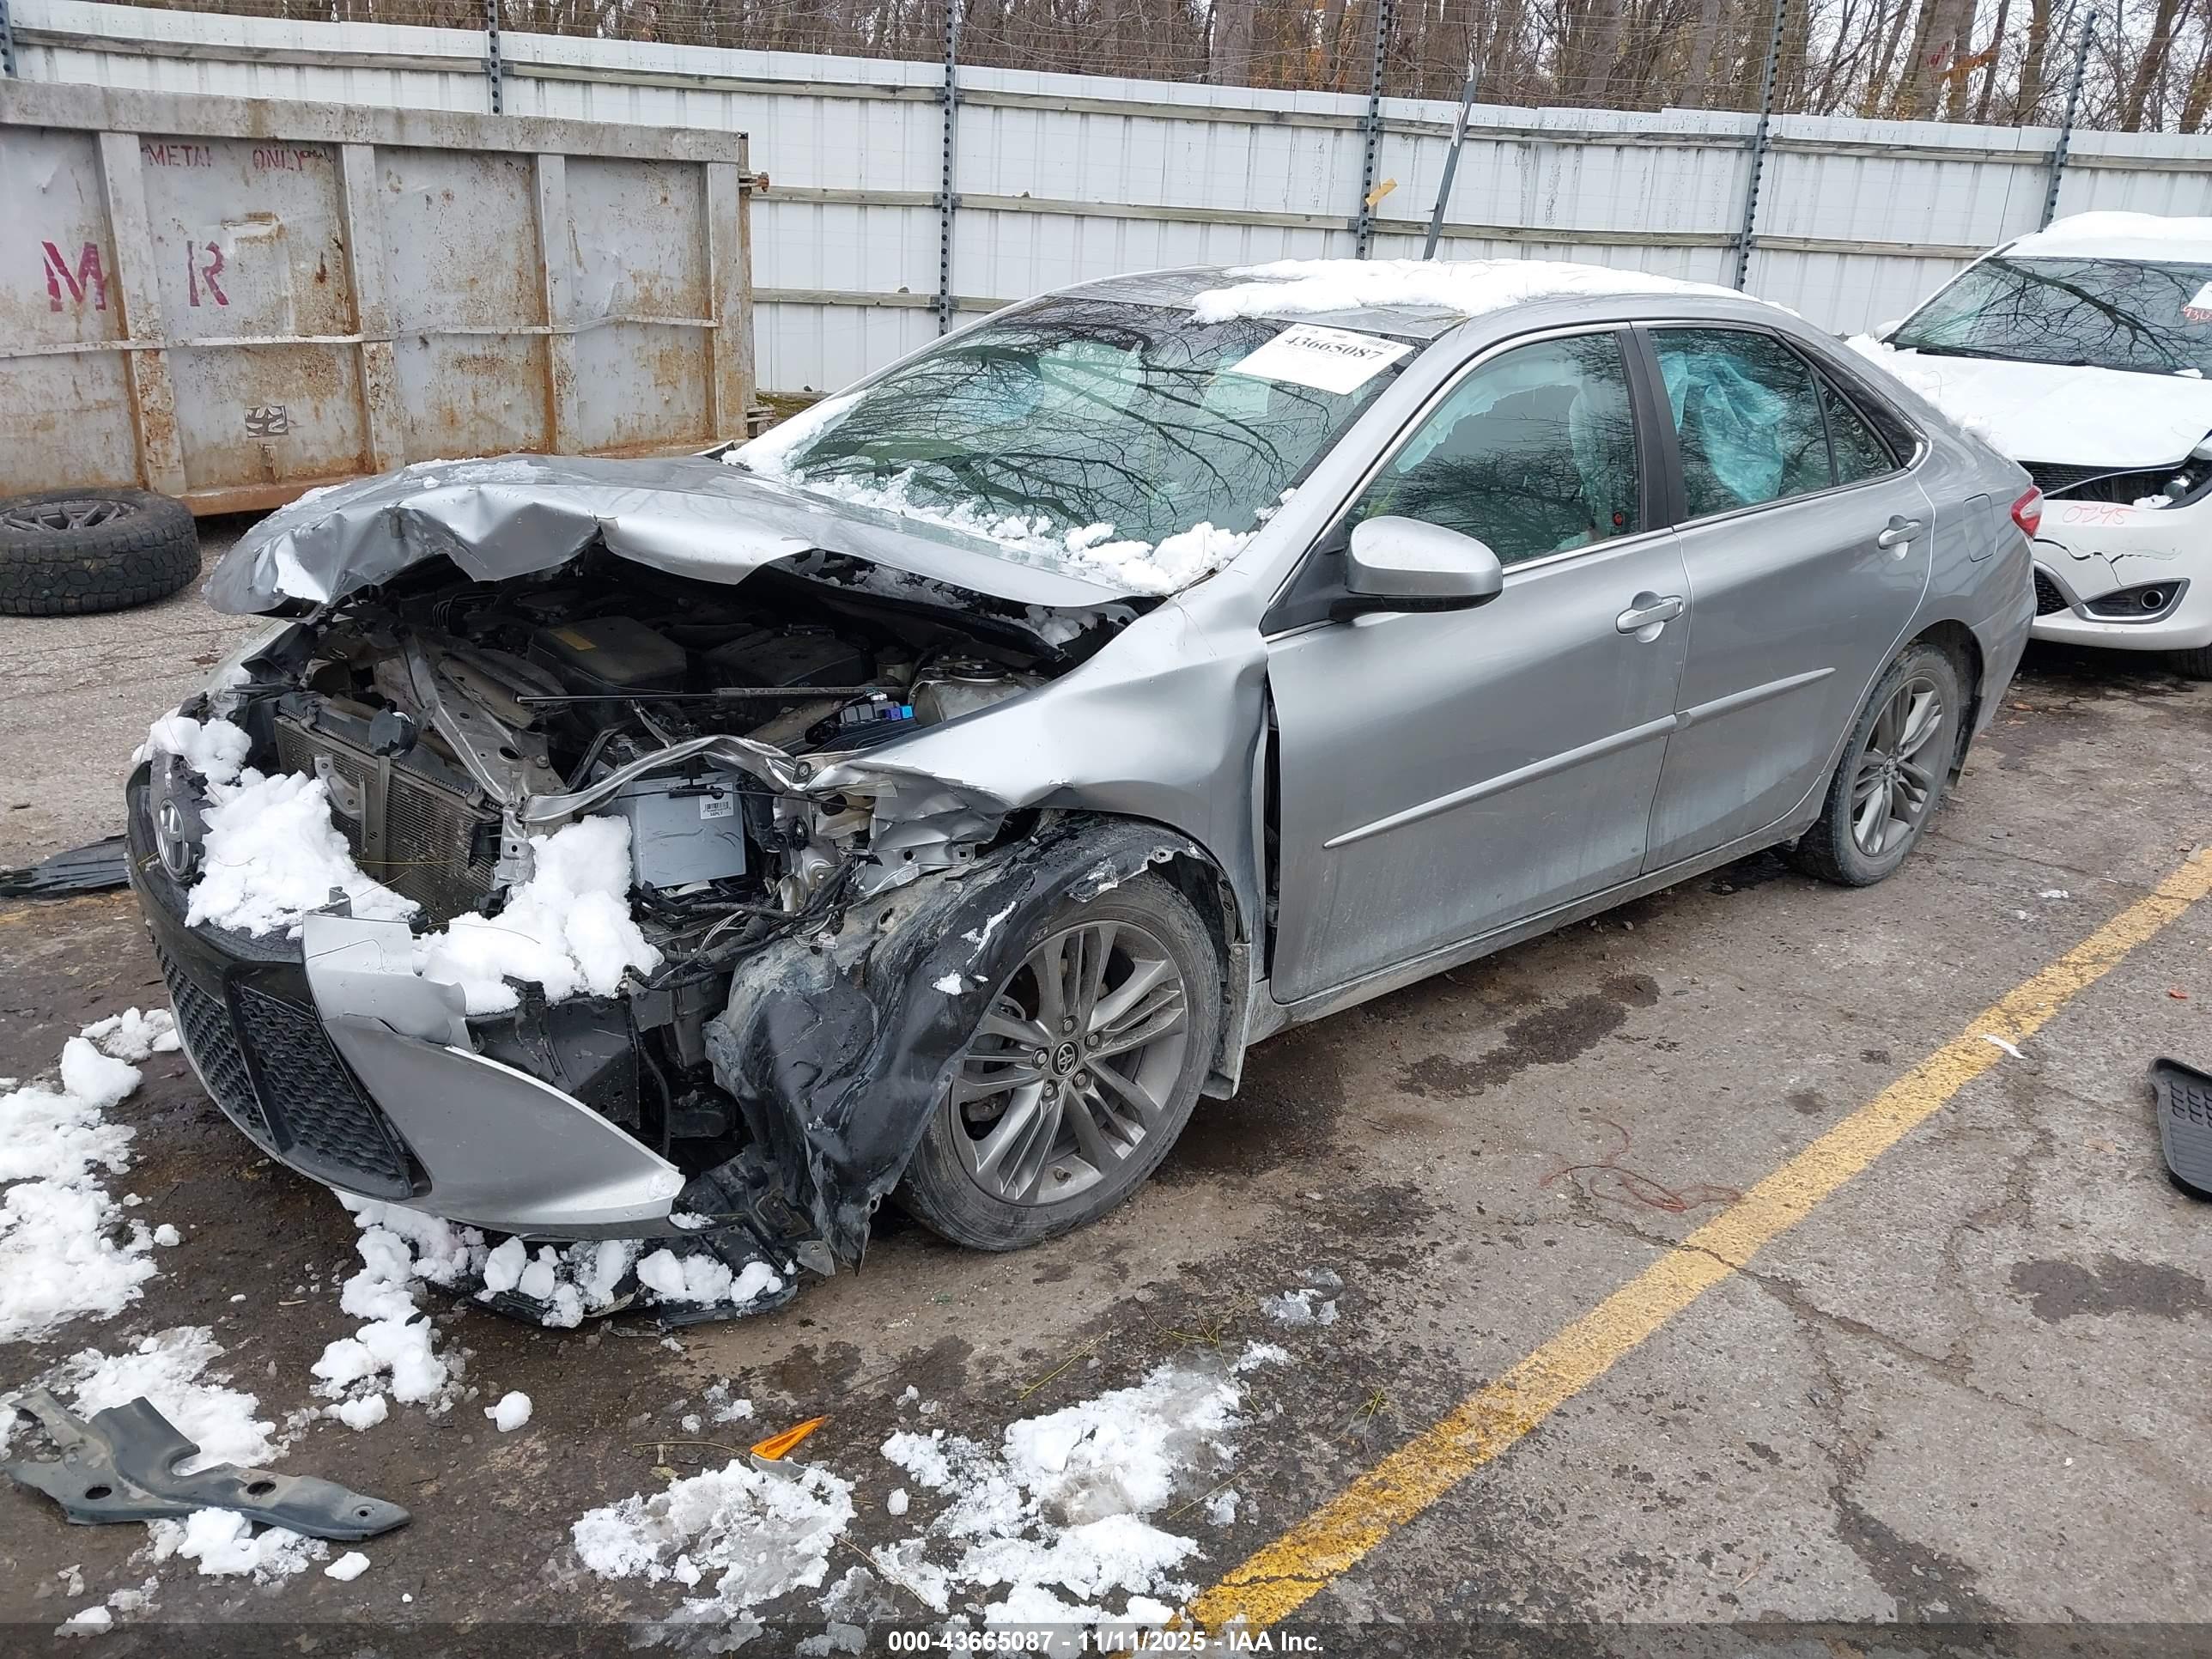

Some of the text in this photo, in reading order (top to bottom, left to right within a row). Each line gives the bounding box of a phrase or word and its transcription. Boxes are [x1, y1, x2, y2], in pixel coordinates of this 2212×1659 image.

[252, 149, 302, 171] ONLY
[41, 240, 229, 312] M R
[1285, 336, 1384, 360] 43665087
